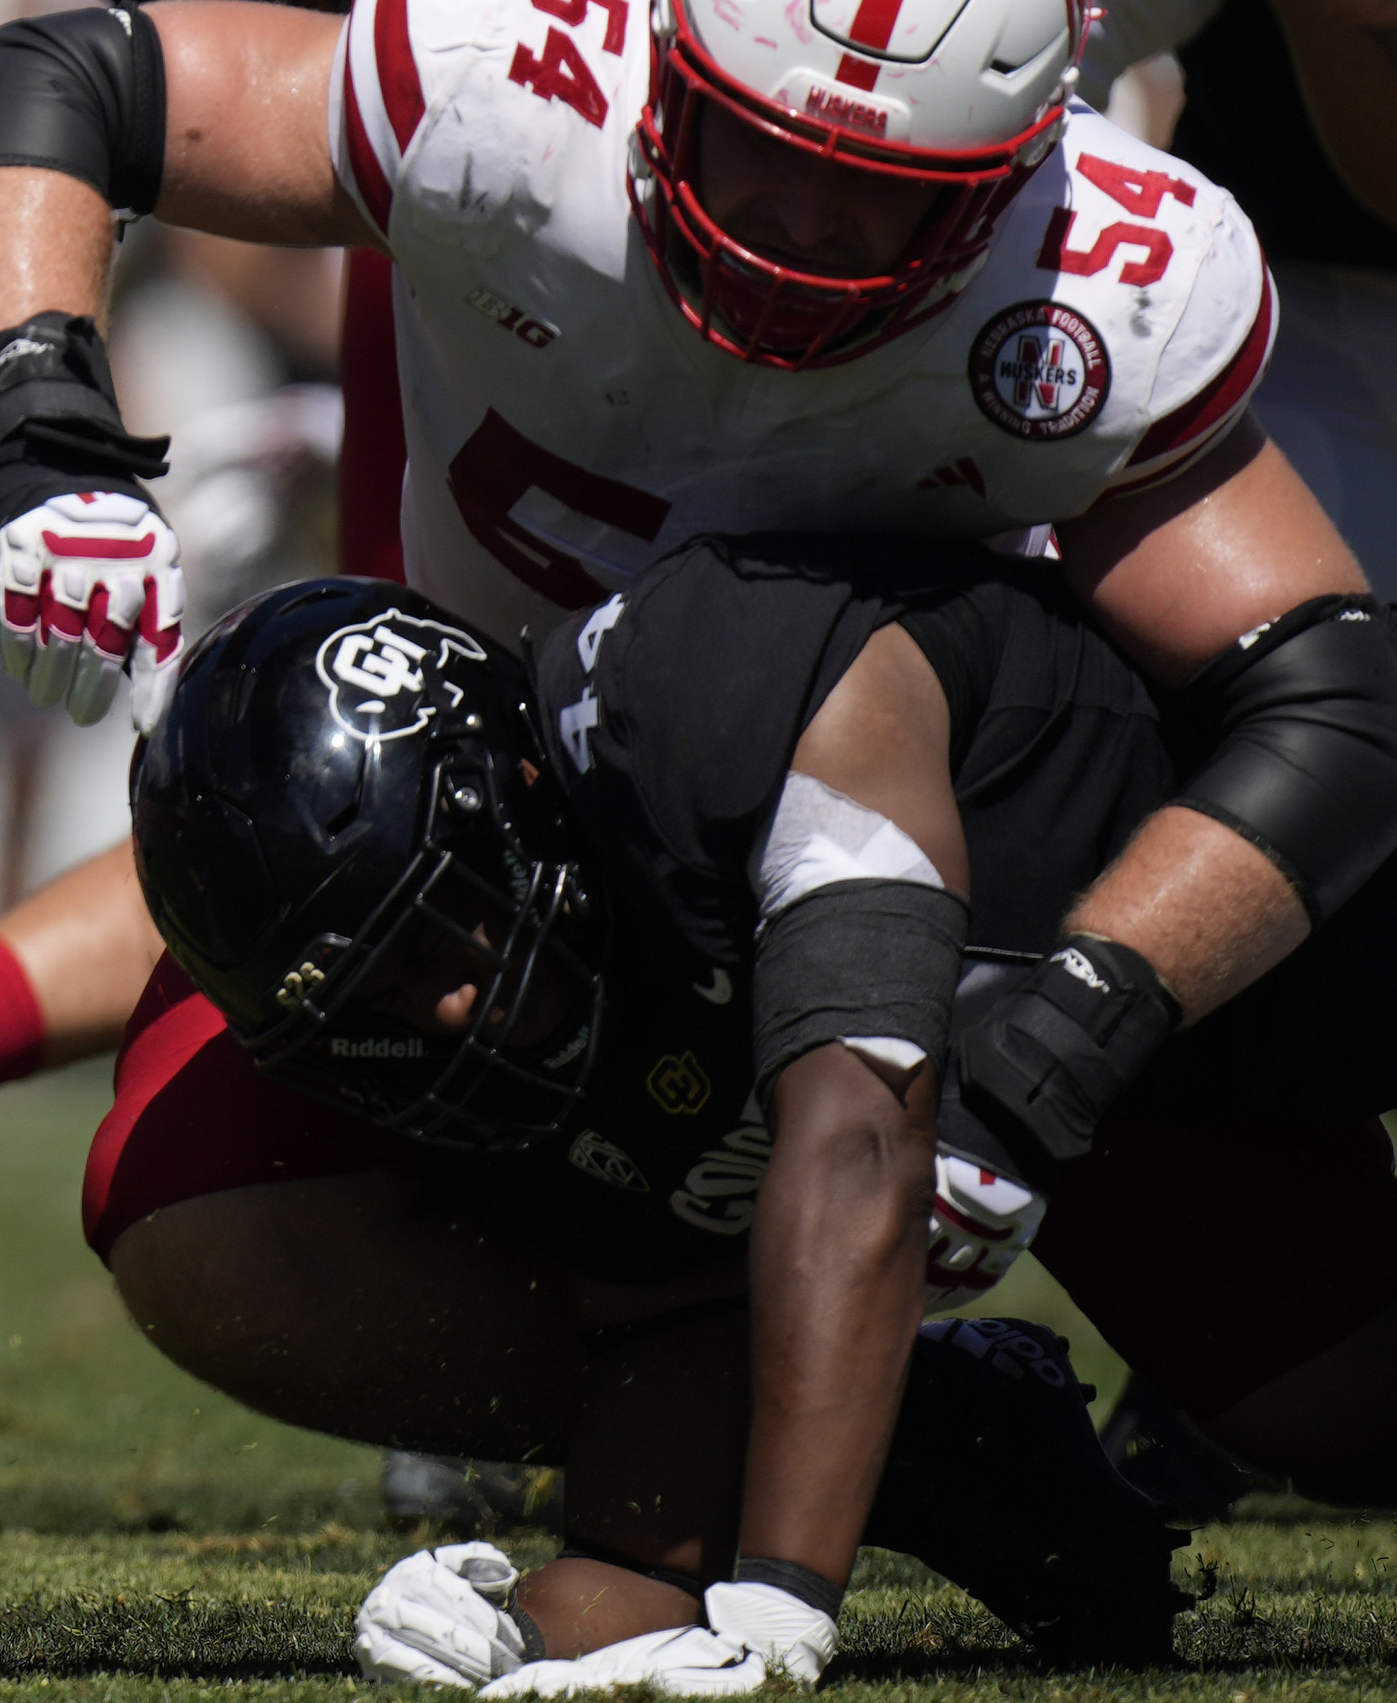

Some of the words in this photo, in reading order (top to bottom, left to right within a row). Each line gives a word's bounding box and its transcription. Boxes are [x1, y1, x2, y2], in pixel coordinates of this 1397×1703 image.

[806, 85, 888, 131] HUSKERS
[1036, 152, 1197, 288] 54
[1052, 308, 1103, 370] FOOTBALL
[1000, 360, 1078, 386] HUSKERS
[331, 1037, 424, 1058] Riddell
